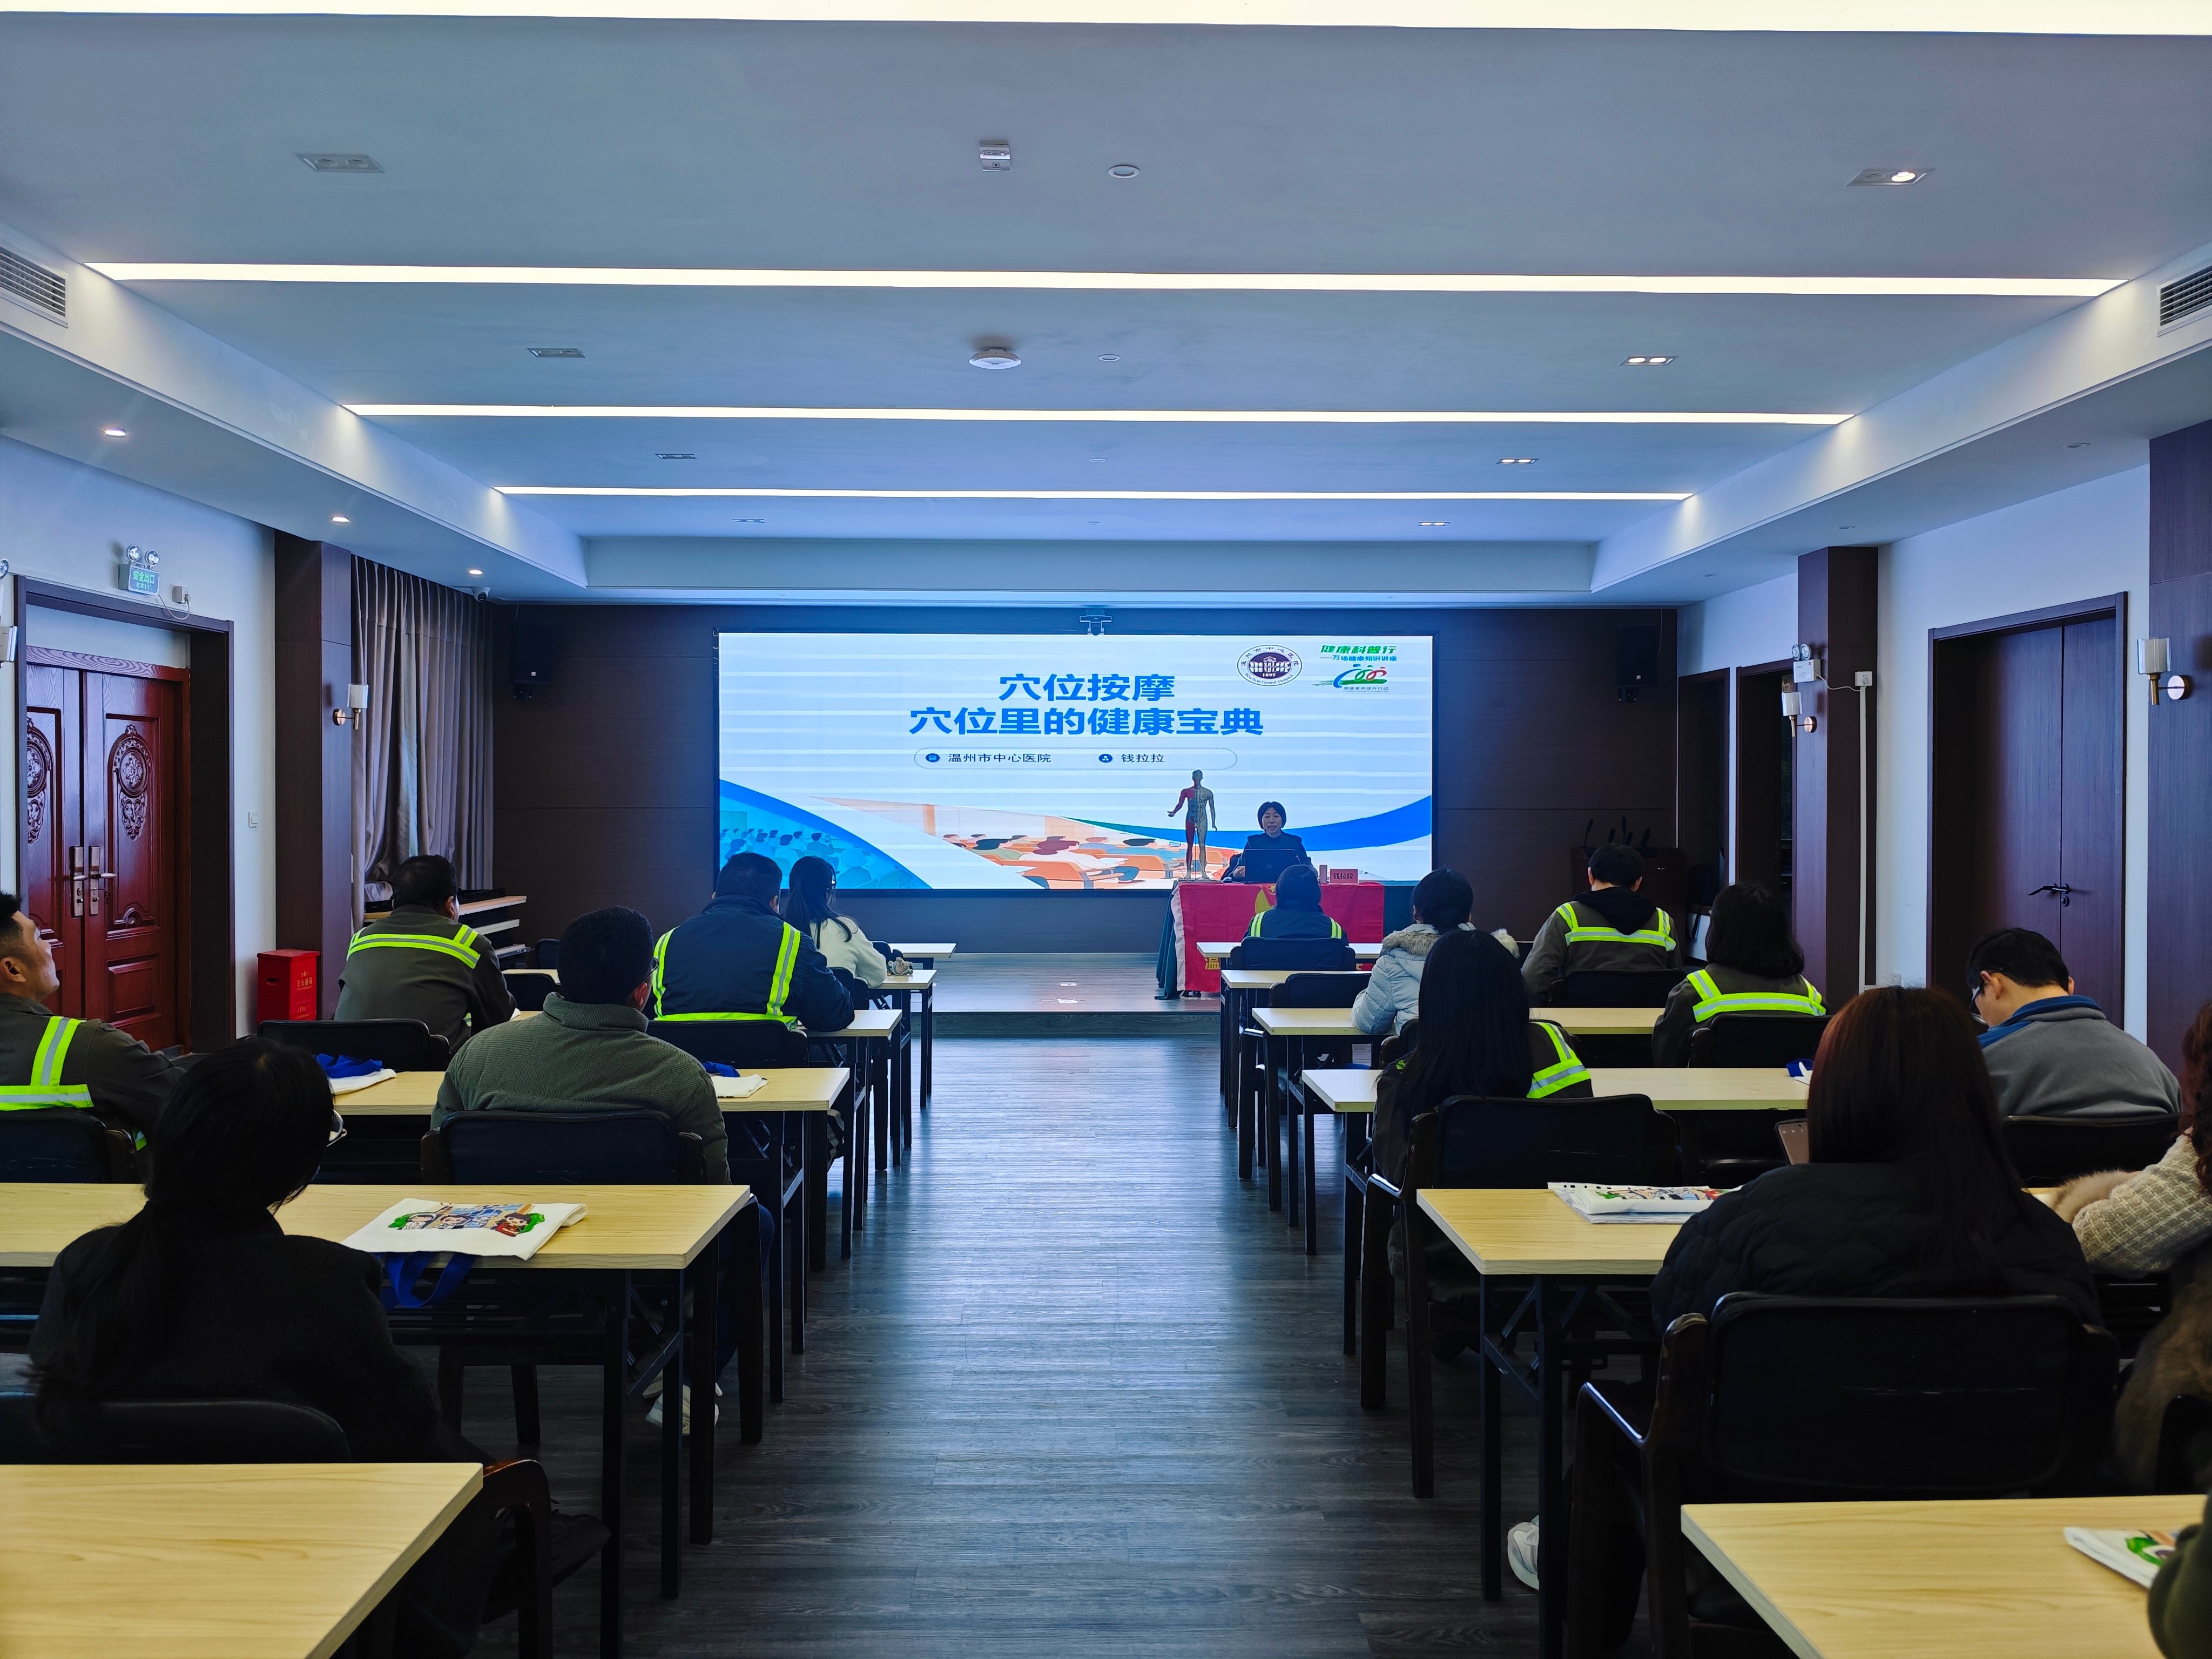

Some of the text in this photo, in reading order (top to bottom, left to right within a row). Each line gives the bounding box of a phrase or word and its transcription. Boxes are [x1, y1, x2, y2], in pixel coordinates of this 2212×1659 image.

[133, 571, 155, 584] 安全出口
[136, 582, 151, 590] EXIT
[1320, 645, 1397, 654] 健康科普行
[998, 673, 1176, 702] 穴位按摩
[909, 706, 1264, 736] 穴位里的健康宝典
[948, 753, 1051, 763] 温州市中心医院
[1121, 753, 1165, 763] 钱拉拉
